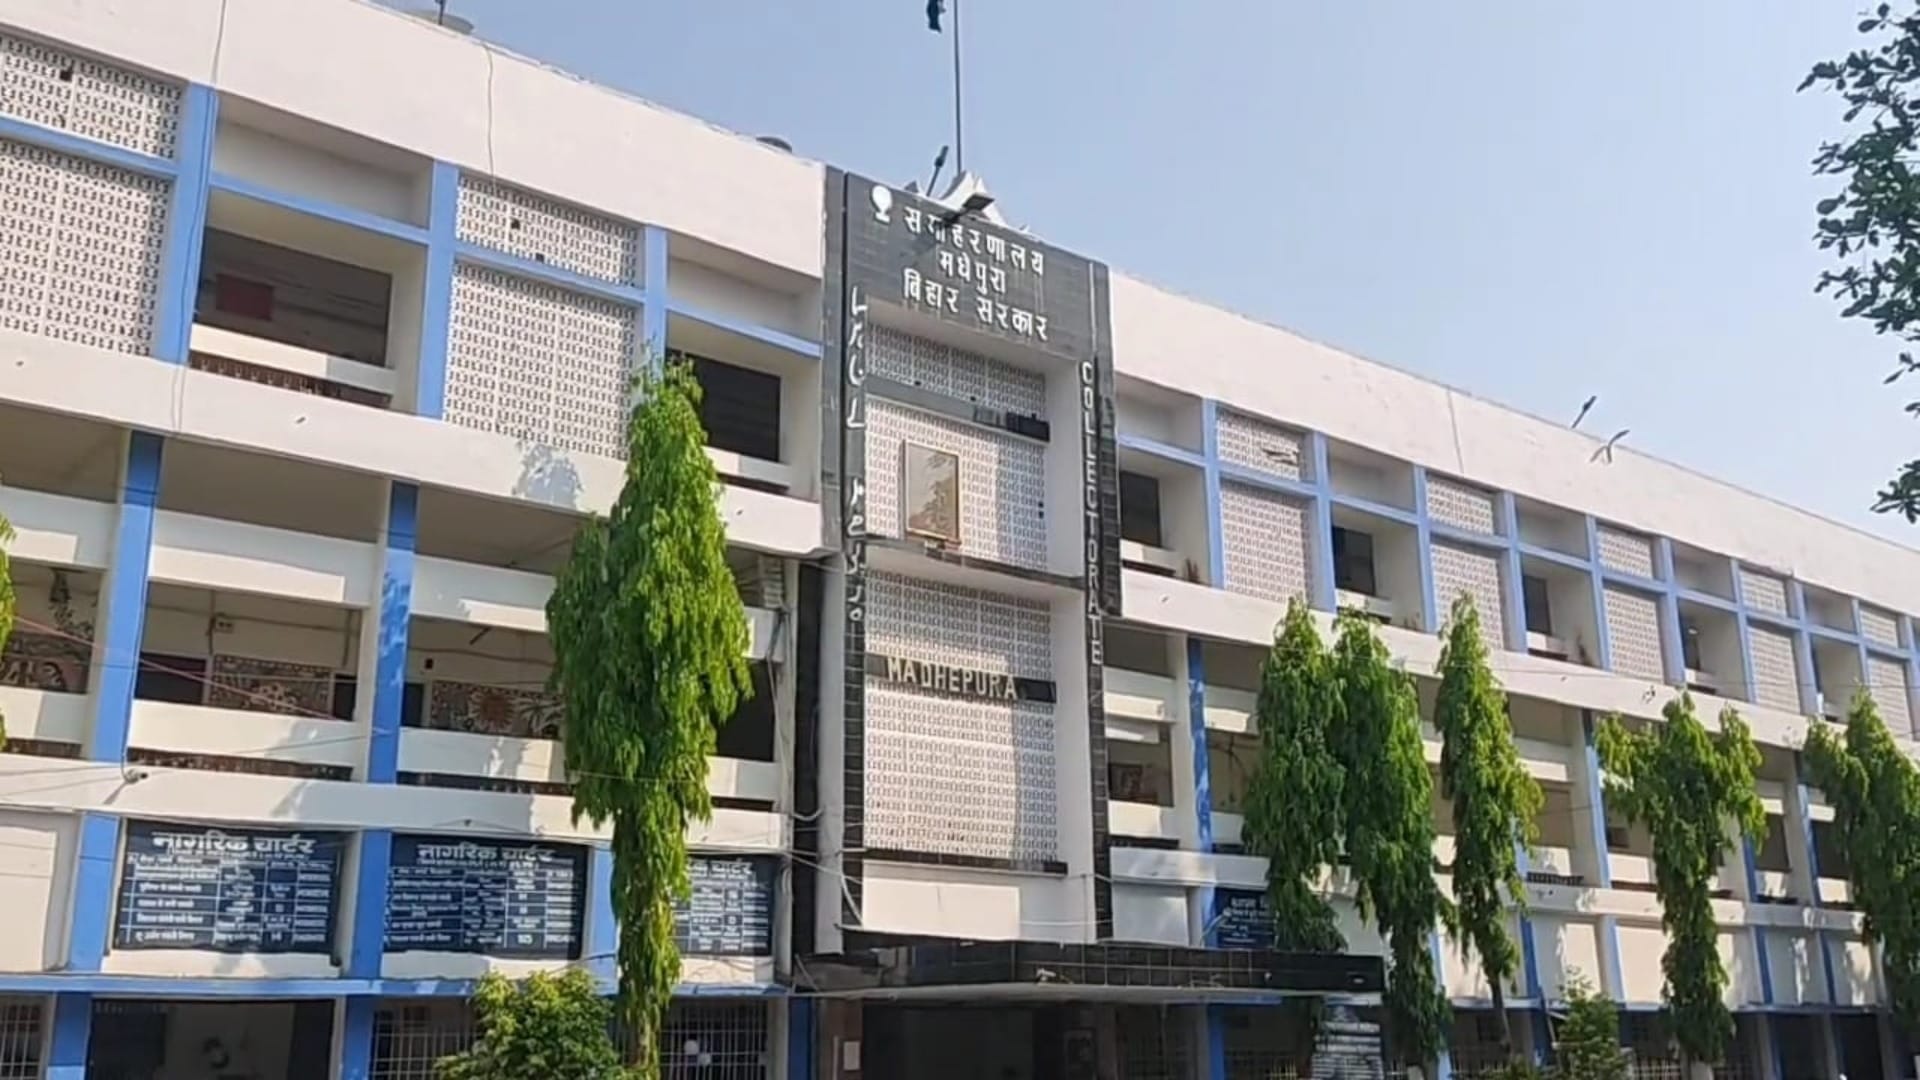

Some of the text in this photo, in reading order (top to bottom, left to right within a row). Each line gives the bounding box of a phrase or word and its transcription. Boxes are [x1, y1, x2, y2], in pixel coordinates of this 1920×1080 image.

[938, 250, 1006, 295] मधेपुरा
[976, 296, 1048, 341] सरकार
[1080, 360, 1103, 666] COLLECTORATE
[886, 656, 1018, 700] MADHEPURA
[151, 830, 317, 854] नागरिक चार्टर
[416, 841, 498, 861] नागरिक
